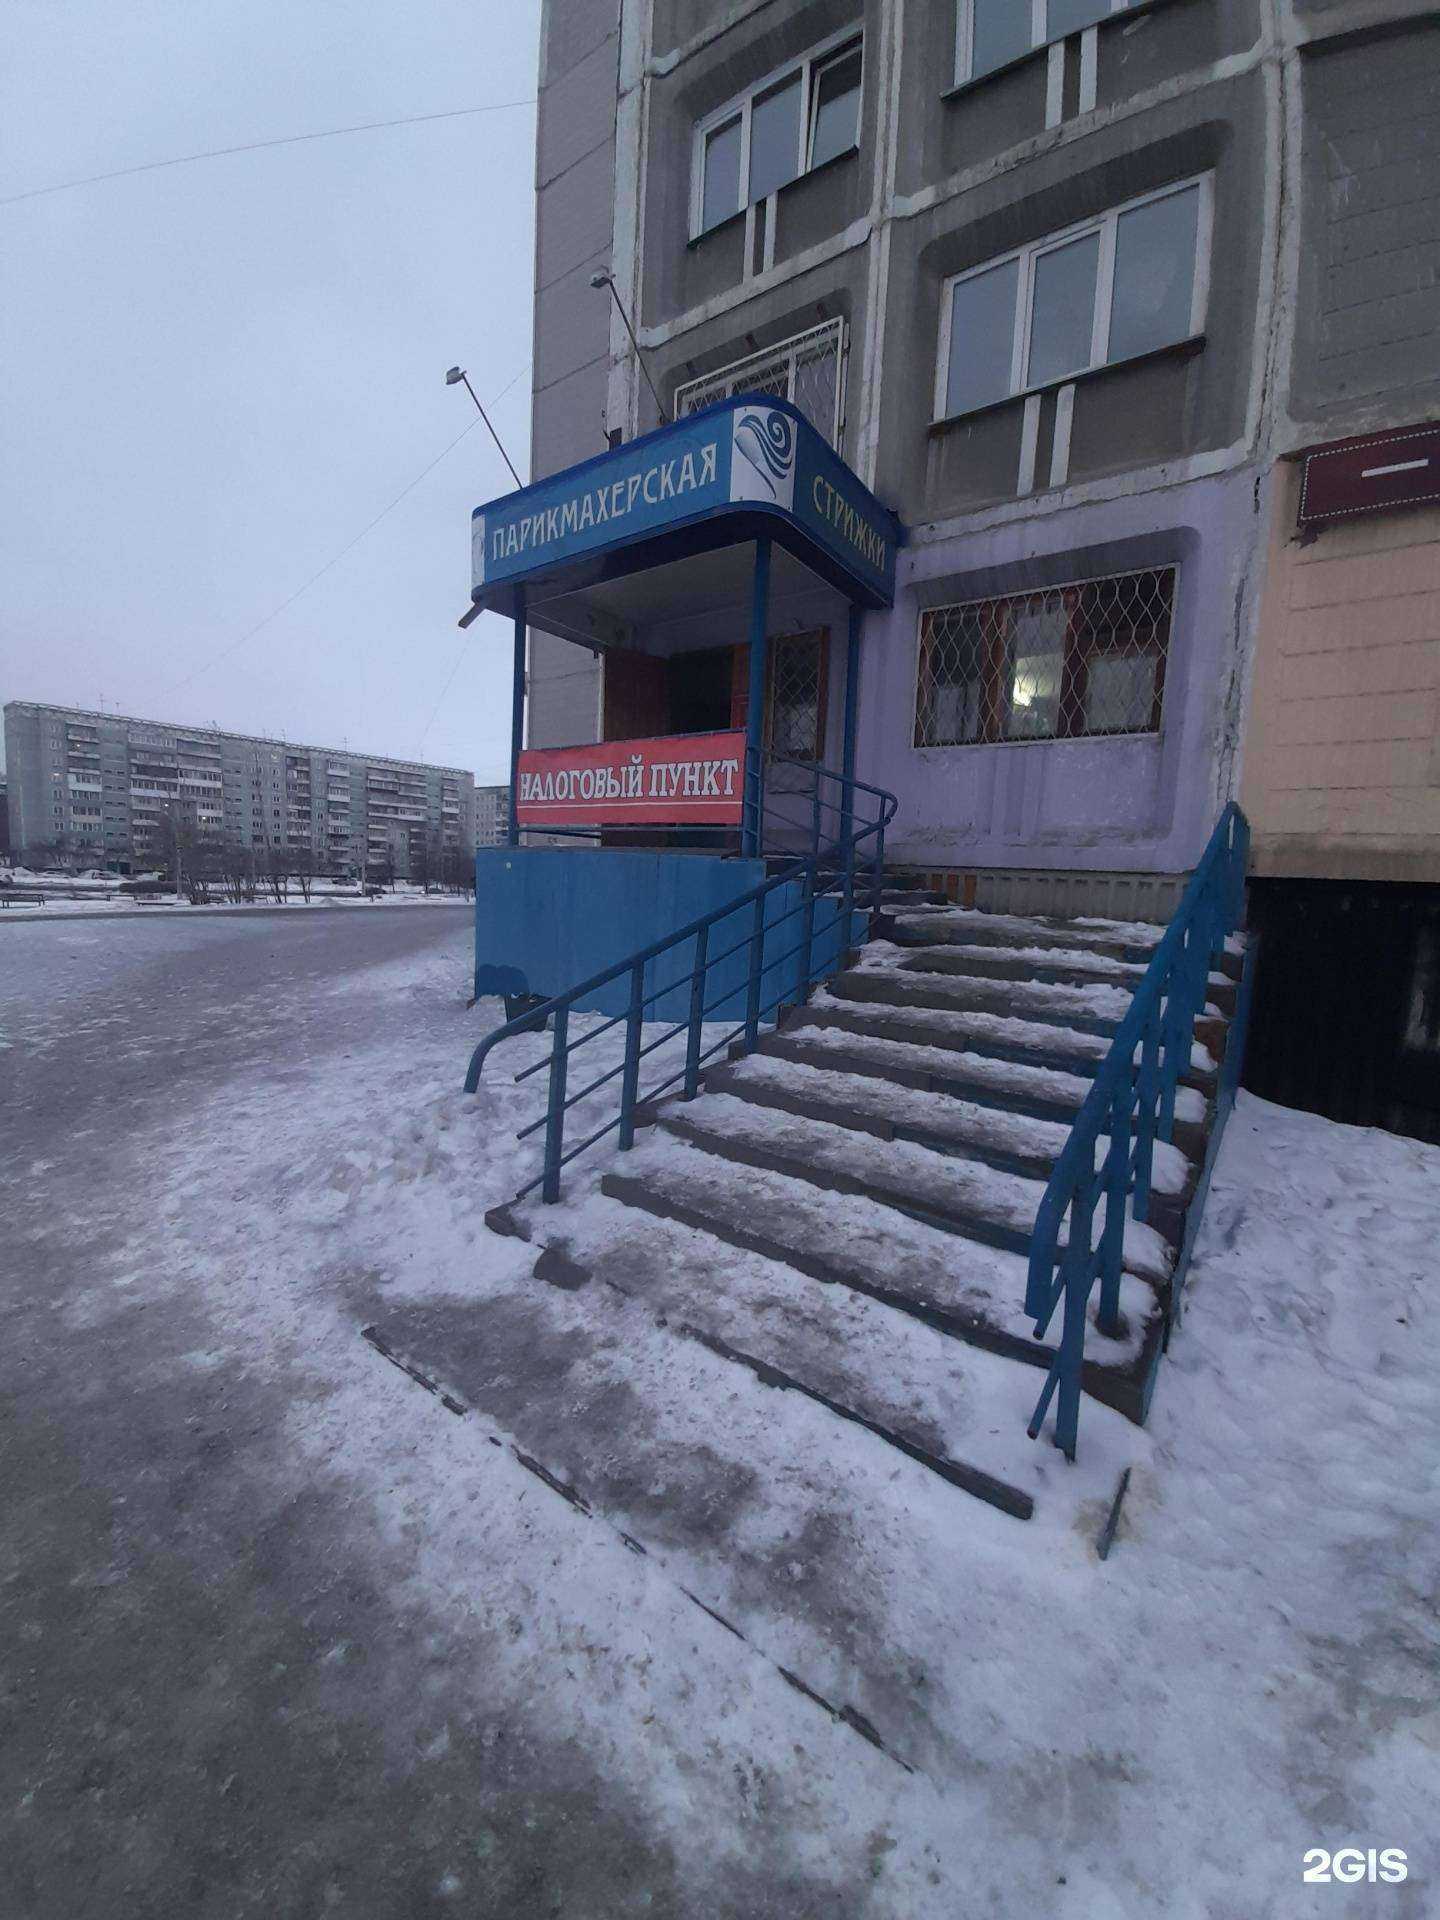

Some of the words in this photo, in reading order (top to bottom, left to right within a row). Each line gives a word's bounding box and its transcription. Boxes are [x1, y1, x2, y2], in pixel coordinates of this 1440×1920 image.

[492, 442, 718, 561] ПАРИКМАХЕРСКАЯ
[813, 475, 886, 572] СТРИЖКИ
[519, 754, 644, 801] НАЛОГОВЫЙ
[648, 759, 739, 796] ПУНКТ
